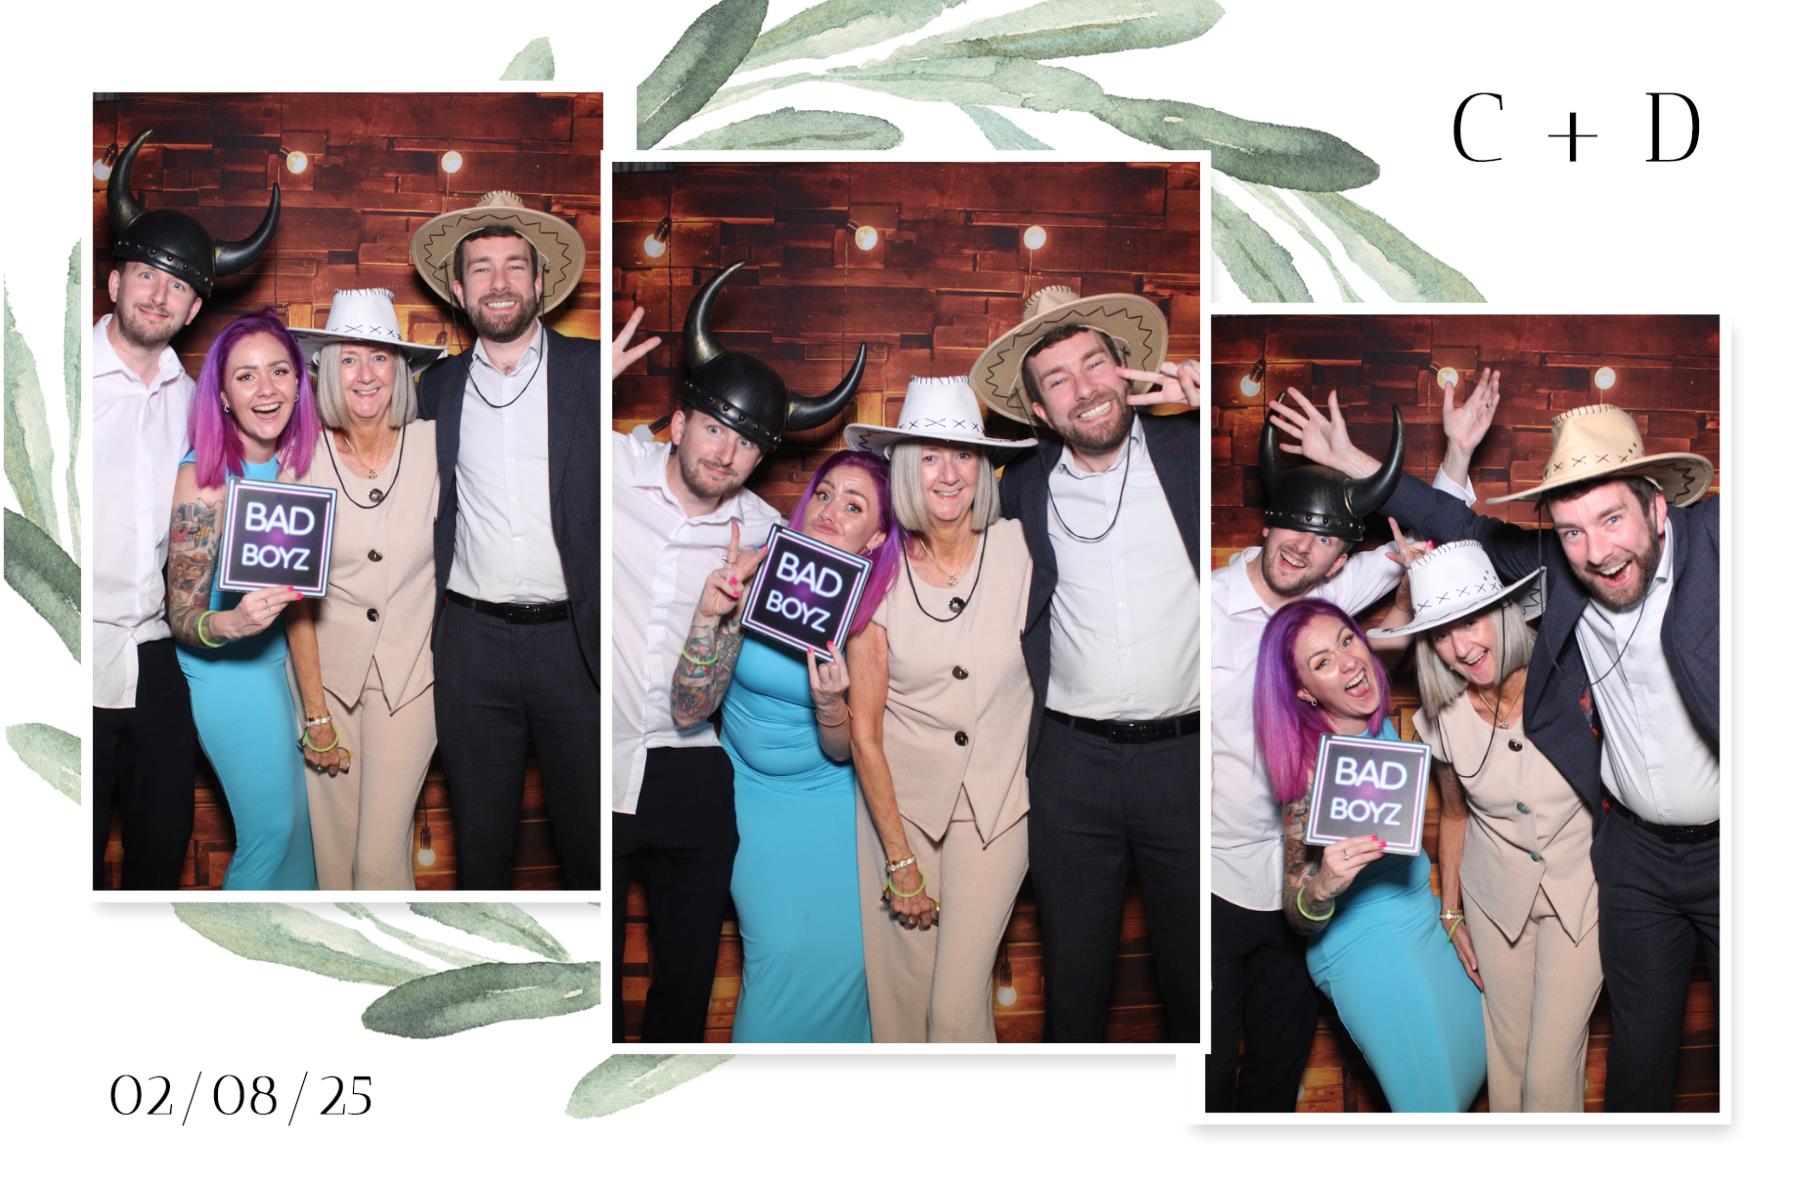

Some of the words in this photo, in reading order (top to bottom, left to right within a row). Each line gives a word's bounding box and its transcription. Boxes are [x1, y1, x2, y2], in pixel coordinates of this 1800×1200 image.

[245, 502, 315, 536] BAD
[242, 542, 311, 571] BOYZ
[776, 550, 843, 598] BAD
[765, 589, 832, 632] BOYZ
[1335, 757, 1407, 790] BAD
[1330, 798, 1402, 827] BOYZ
